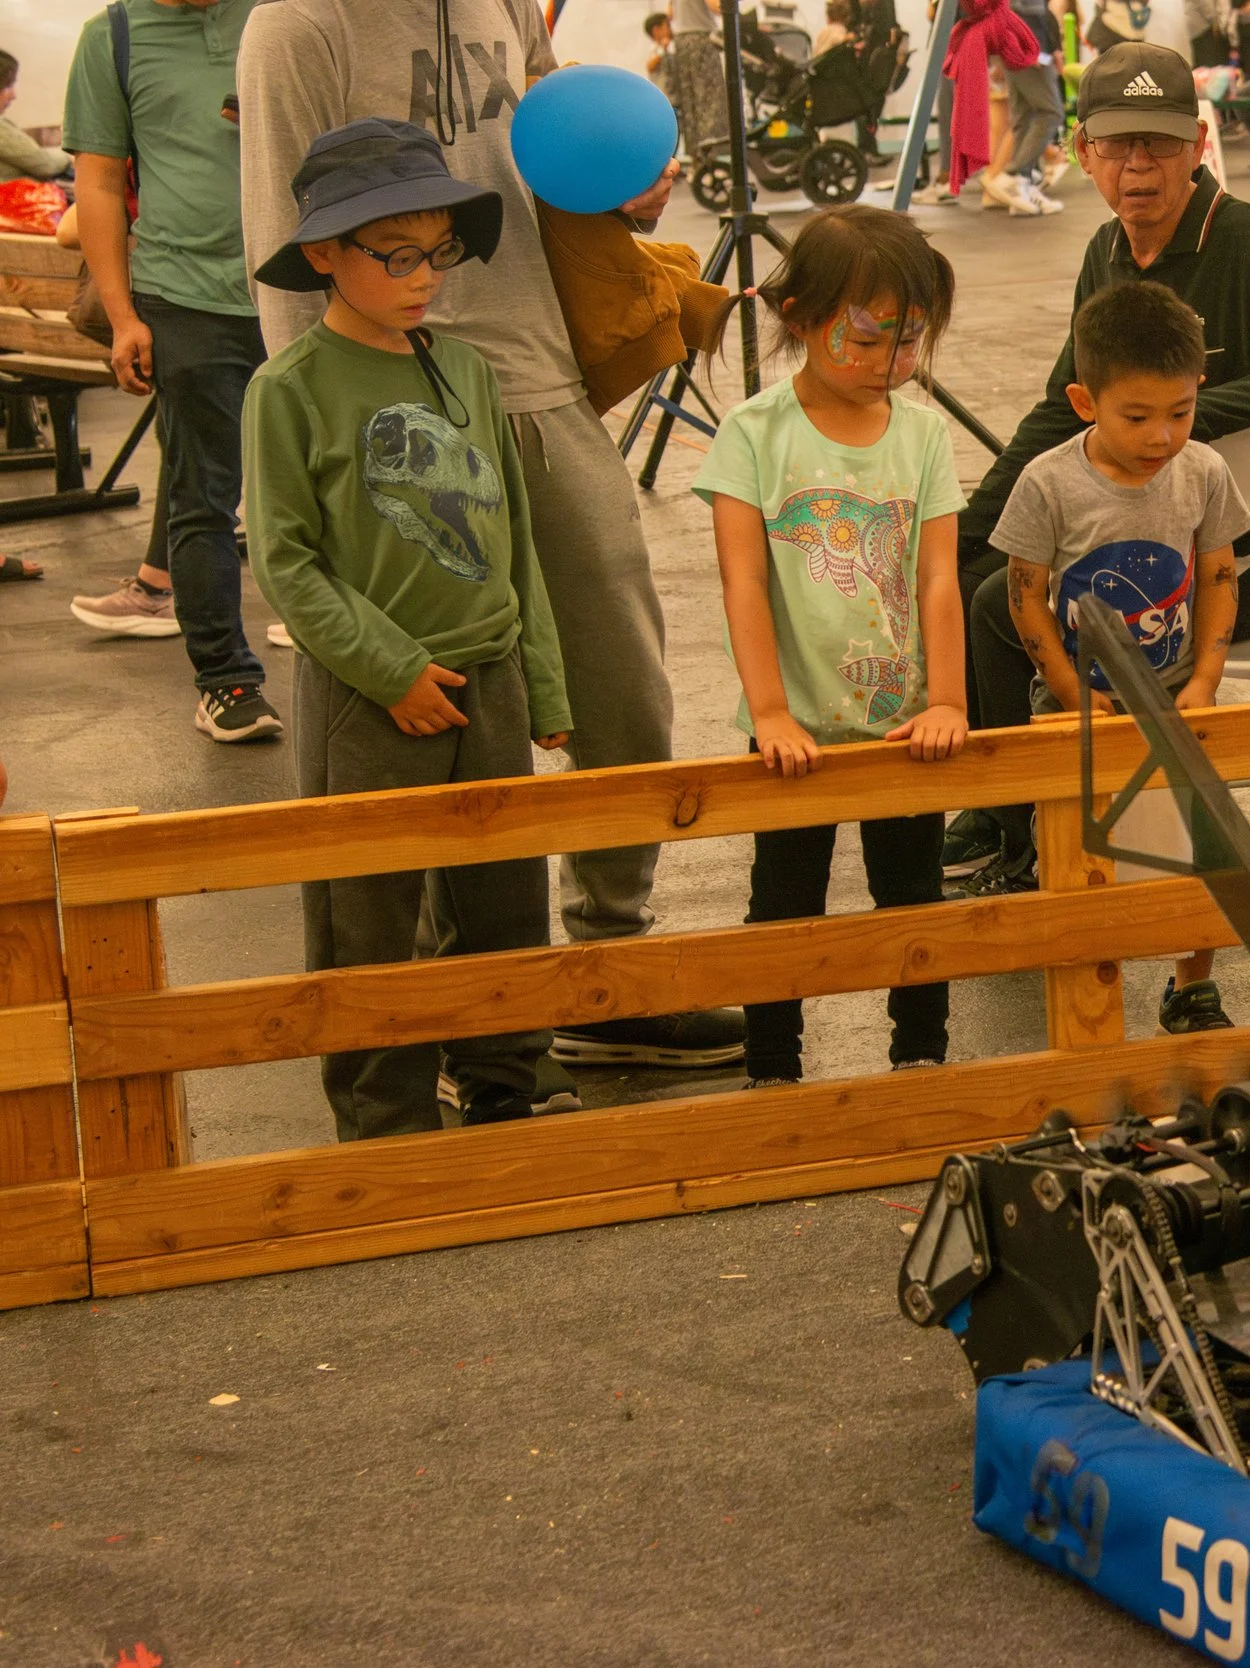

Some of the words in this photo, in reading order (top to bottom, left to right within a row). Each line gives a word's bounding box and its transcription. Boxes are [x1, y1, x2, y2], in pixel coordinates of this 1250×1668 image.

[1123, 85, 1164, 97] adidas
[1067, 598, 1189, 646] SA
[1159, 1515, 1250, 1663] 59
